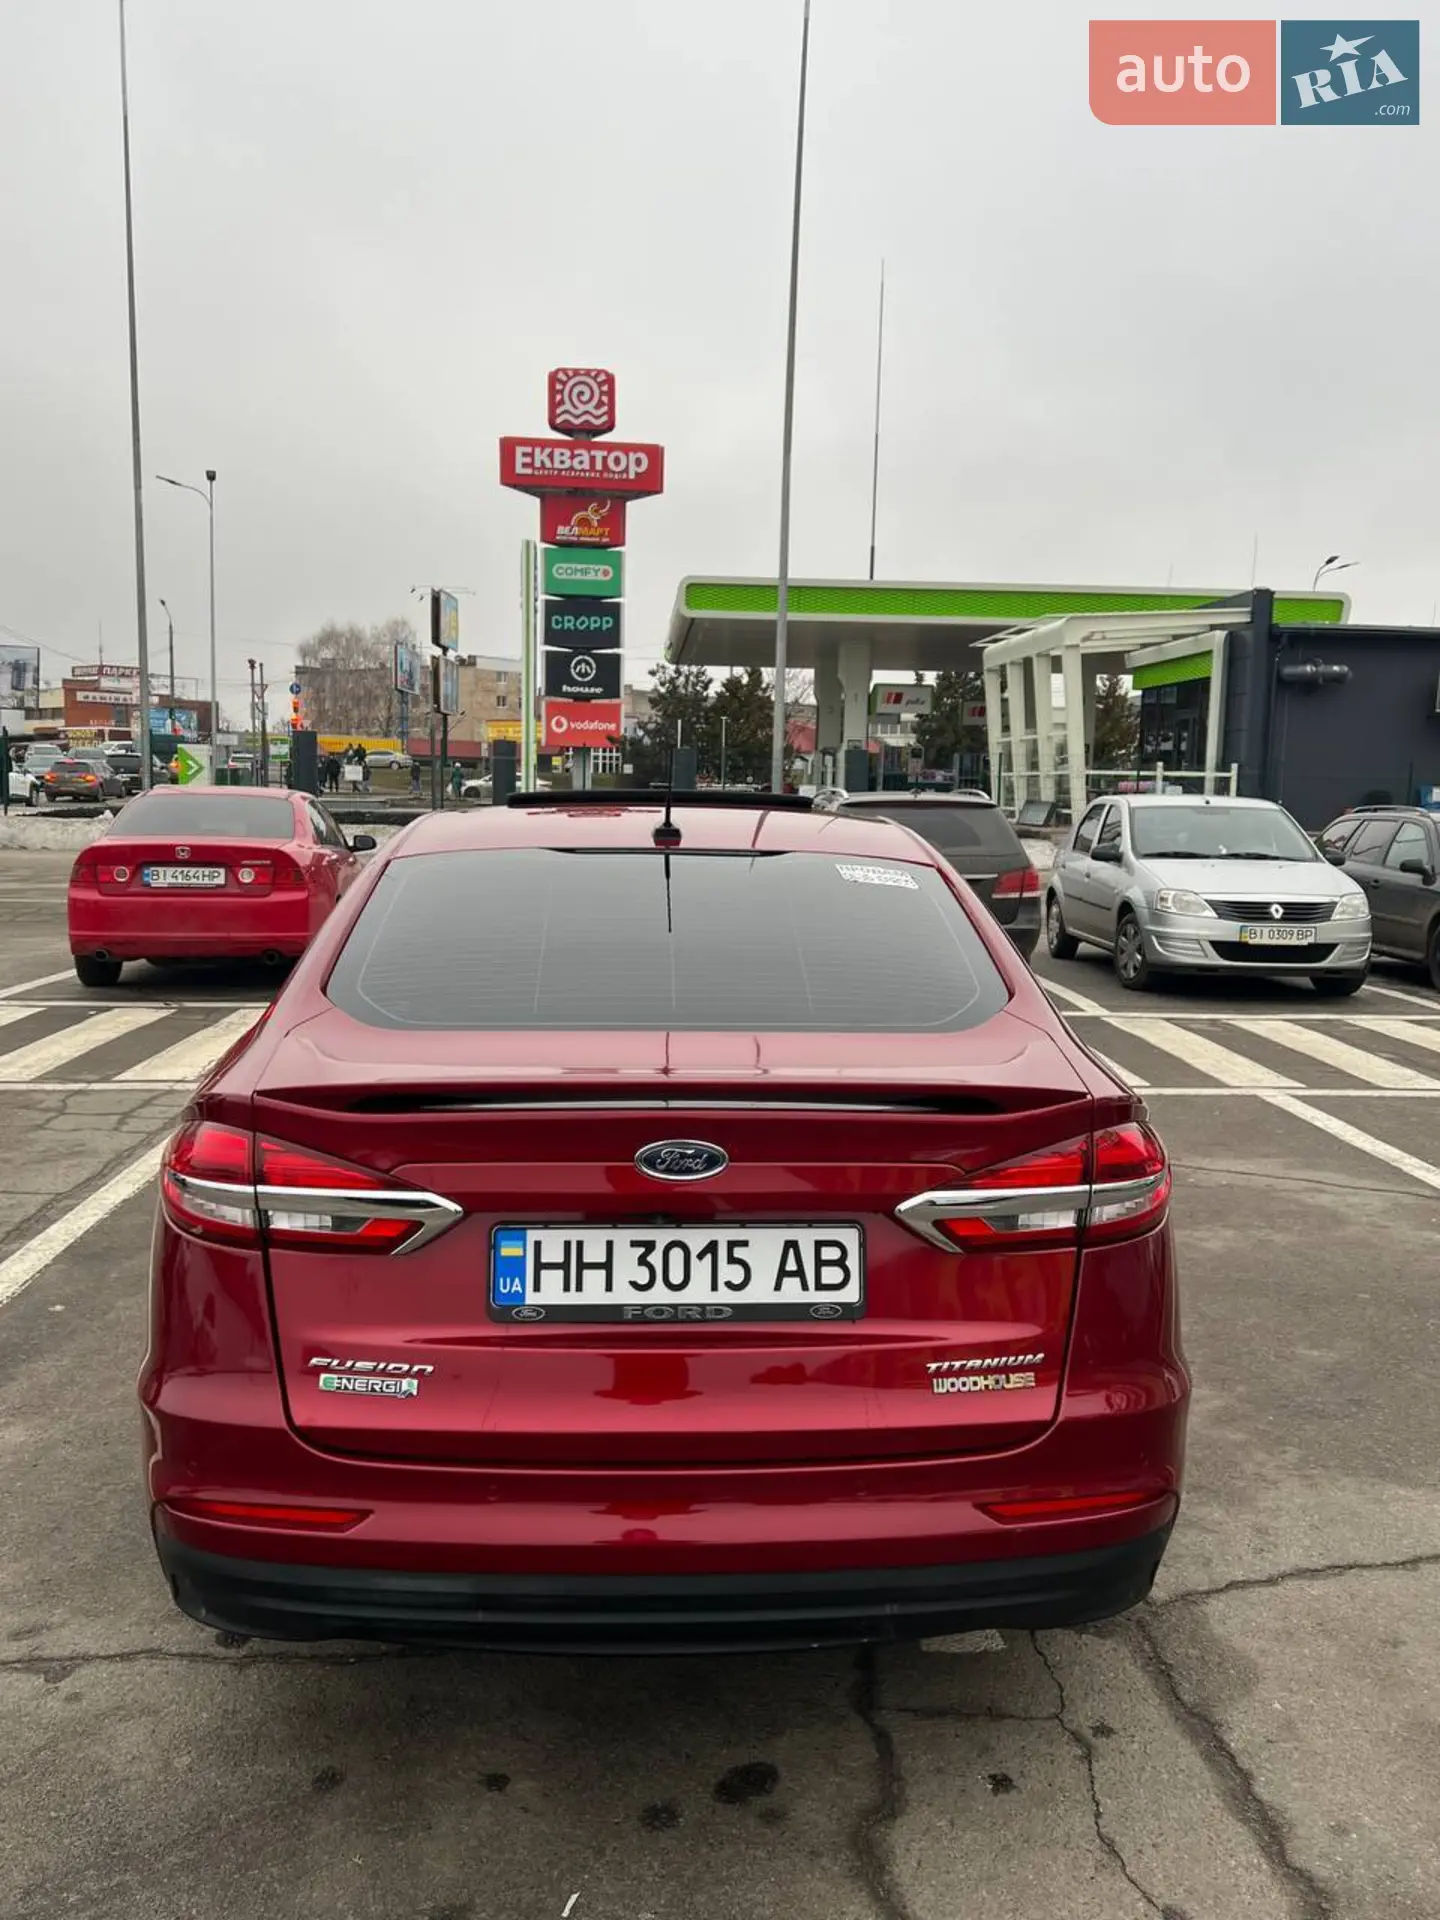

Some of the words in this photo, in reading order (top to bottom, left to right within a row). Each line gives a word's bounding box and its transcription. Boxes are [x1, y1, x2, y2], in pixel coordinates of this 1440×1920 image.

[555, 566, 601, 578] COMFY
[551, 615, 614, 631] CROPP
[103, 667, 140, 677] ПАРКЕ
[569, 720, 617, 732] vodafone
[151, 869, 167, 881] BI
[1248, 928, 1263, 940] BI
[656, 1148, 708, 1171] Ford
[533, 1240, 613, 1292] HH
[628, 1239, 752, 1293] 3015
[773, 1240, 851, 1292] AB
[500, 1276, 523, 1294] UA
[622, 1305, 733, 1319] FORD
[308, 1357, 434, 1375] FUSION
[925, 1353, 1045, 1374] TITANIUM
[322, 1376, 401, 1393] ENERGI
[932, 1372, 1036, 1394] WOODHOUSE
